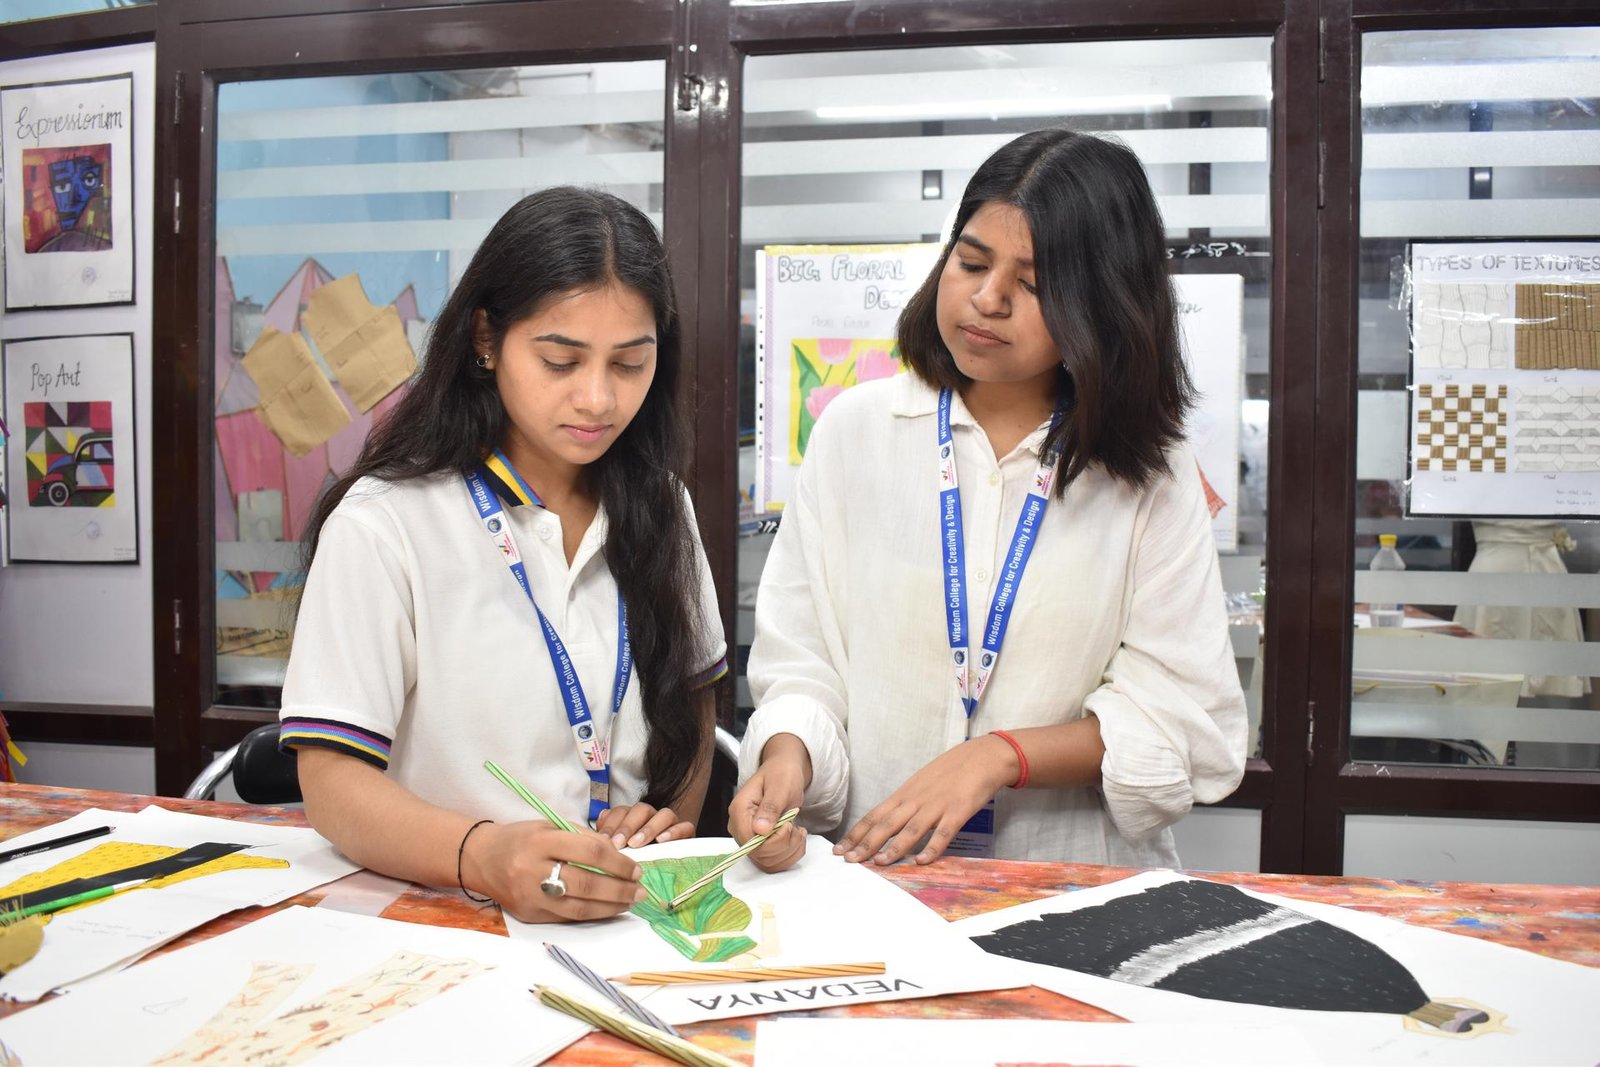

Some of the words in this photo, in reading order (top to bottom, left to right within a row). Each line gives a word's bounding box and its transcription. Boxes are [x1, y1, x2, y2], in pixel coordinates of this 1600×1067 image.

[831, 254, 906, 281] FLORAL
[1416, 255, 1472, 271] TYPES
[1482, 255, 1506, 270] OF
[31, 363, 52, 397] Pop
[55, 361, 81, 387] Art
[472, 477, 492, 513] Wisdom
[945, 494, 956, 520] Design
[1023, 500, 1040, 526] Design
[947, 528, 958, 564] Creativity
[1008, 533, 1031, 571] Creativity
[950, 565, 958, 578] for
[1005, 568, 1016, 581] for
[950, 578, 961, 609] College
[995, 582, 1012, 612] College
[951, 610, 961, 643] Wisdom
[987, 613, 1002, 646] Wisdom
[555, 641, 564, 655] for
[621, 641, 631, 673] College
[560, 654, 575, 686] College
[569, 685, 585, 719] Wisdom
[687, 978, 924, 1010] VEDANYA
